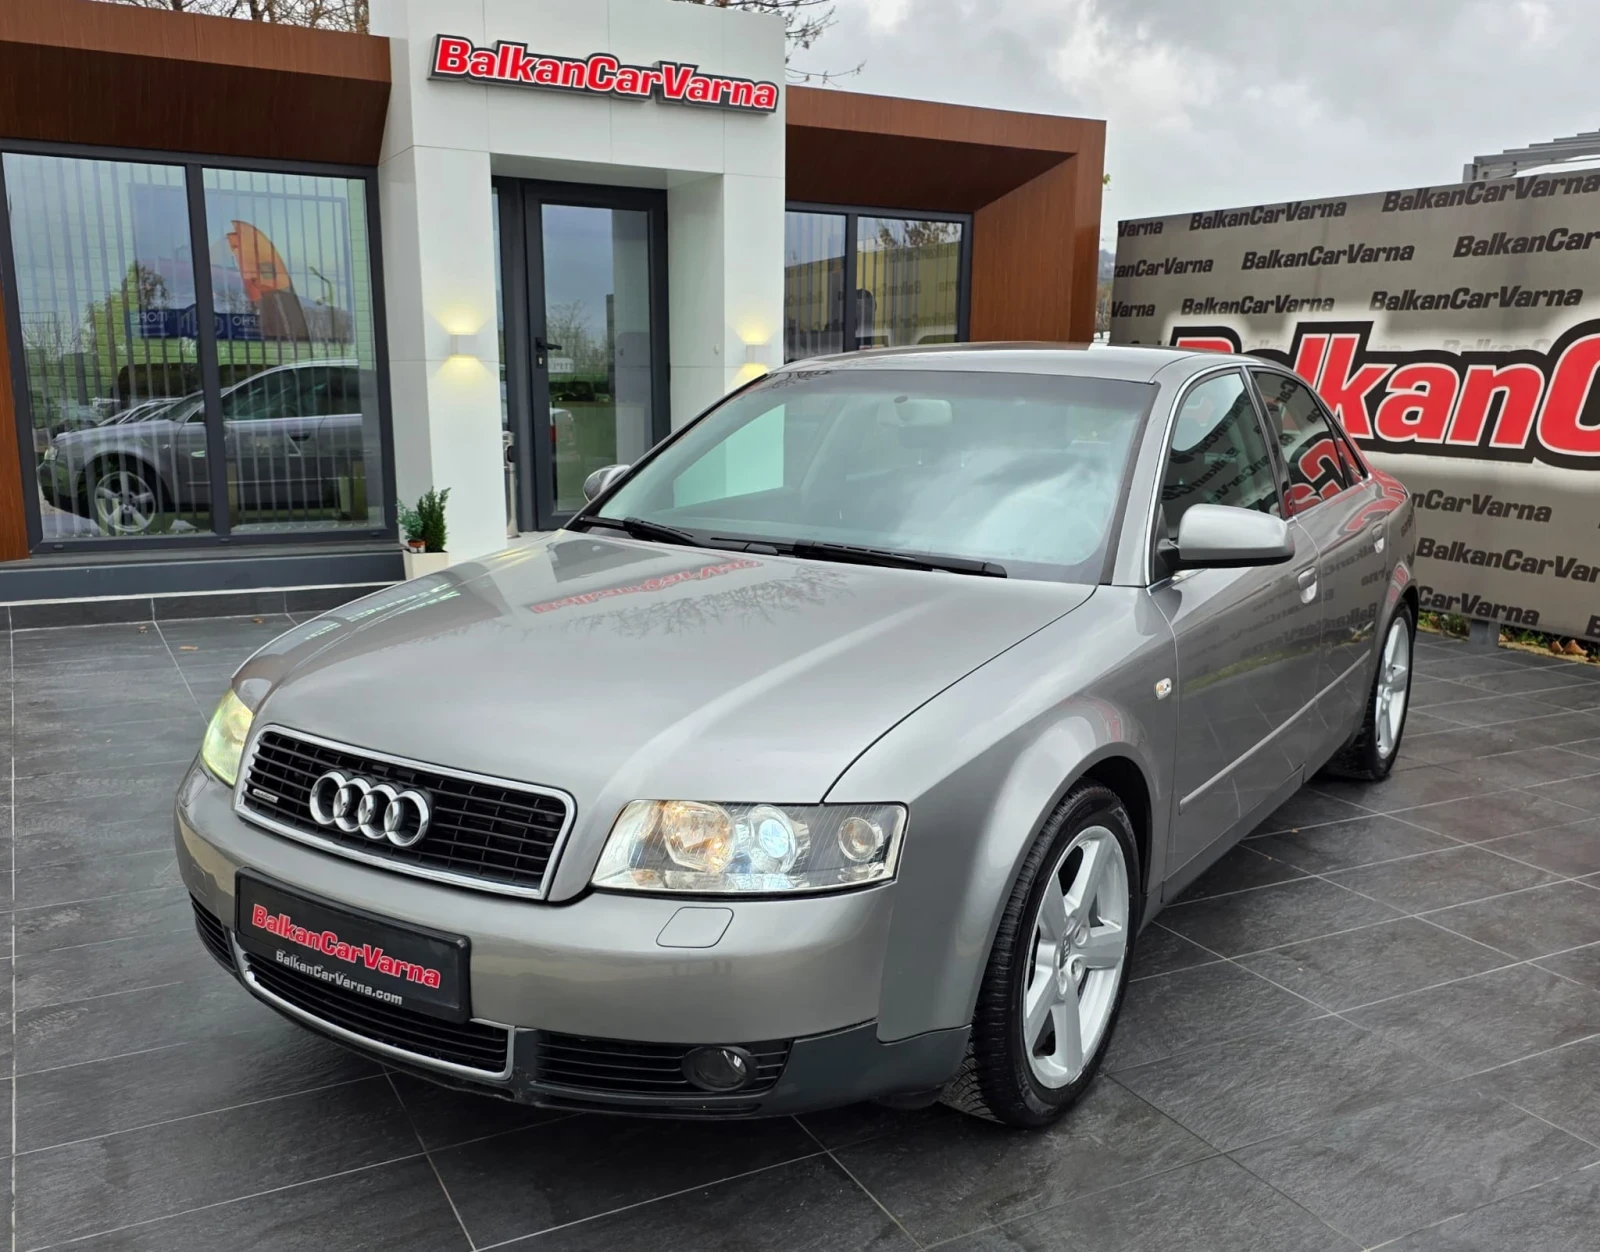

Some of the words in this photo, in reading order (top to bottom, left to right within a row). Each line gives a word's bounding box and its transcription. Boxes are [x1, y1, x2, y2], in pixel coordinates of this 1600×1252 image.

[434, 36, 778, 109] BalkanCarVarna
[1381, 174, 1600, 213] BalkanCarVarna
[1189, 200, 1347, 231] BalkanCarVarna
[1241, 243, 1415, 271] BalkanCarVarna
[1180, 295, 1335, 316] BalkanCarVarna
[1369, 286, 1584, 312] BalkanCarVarna
[252, 903, 441, 989] BalkanCarVarna
[276, 949, 403, 1005] BalkanCarVarna.com
